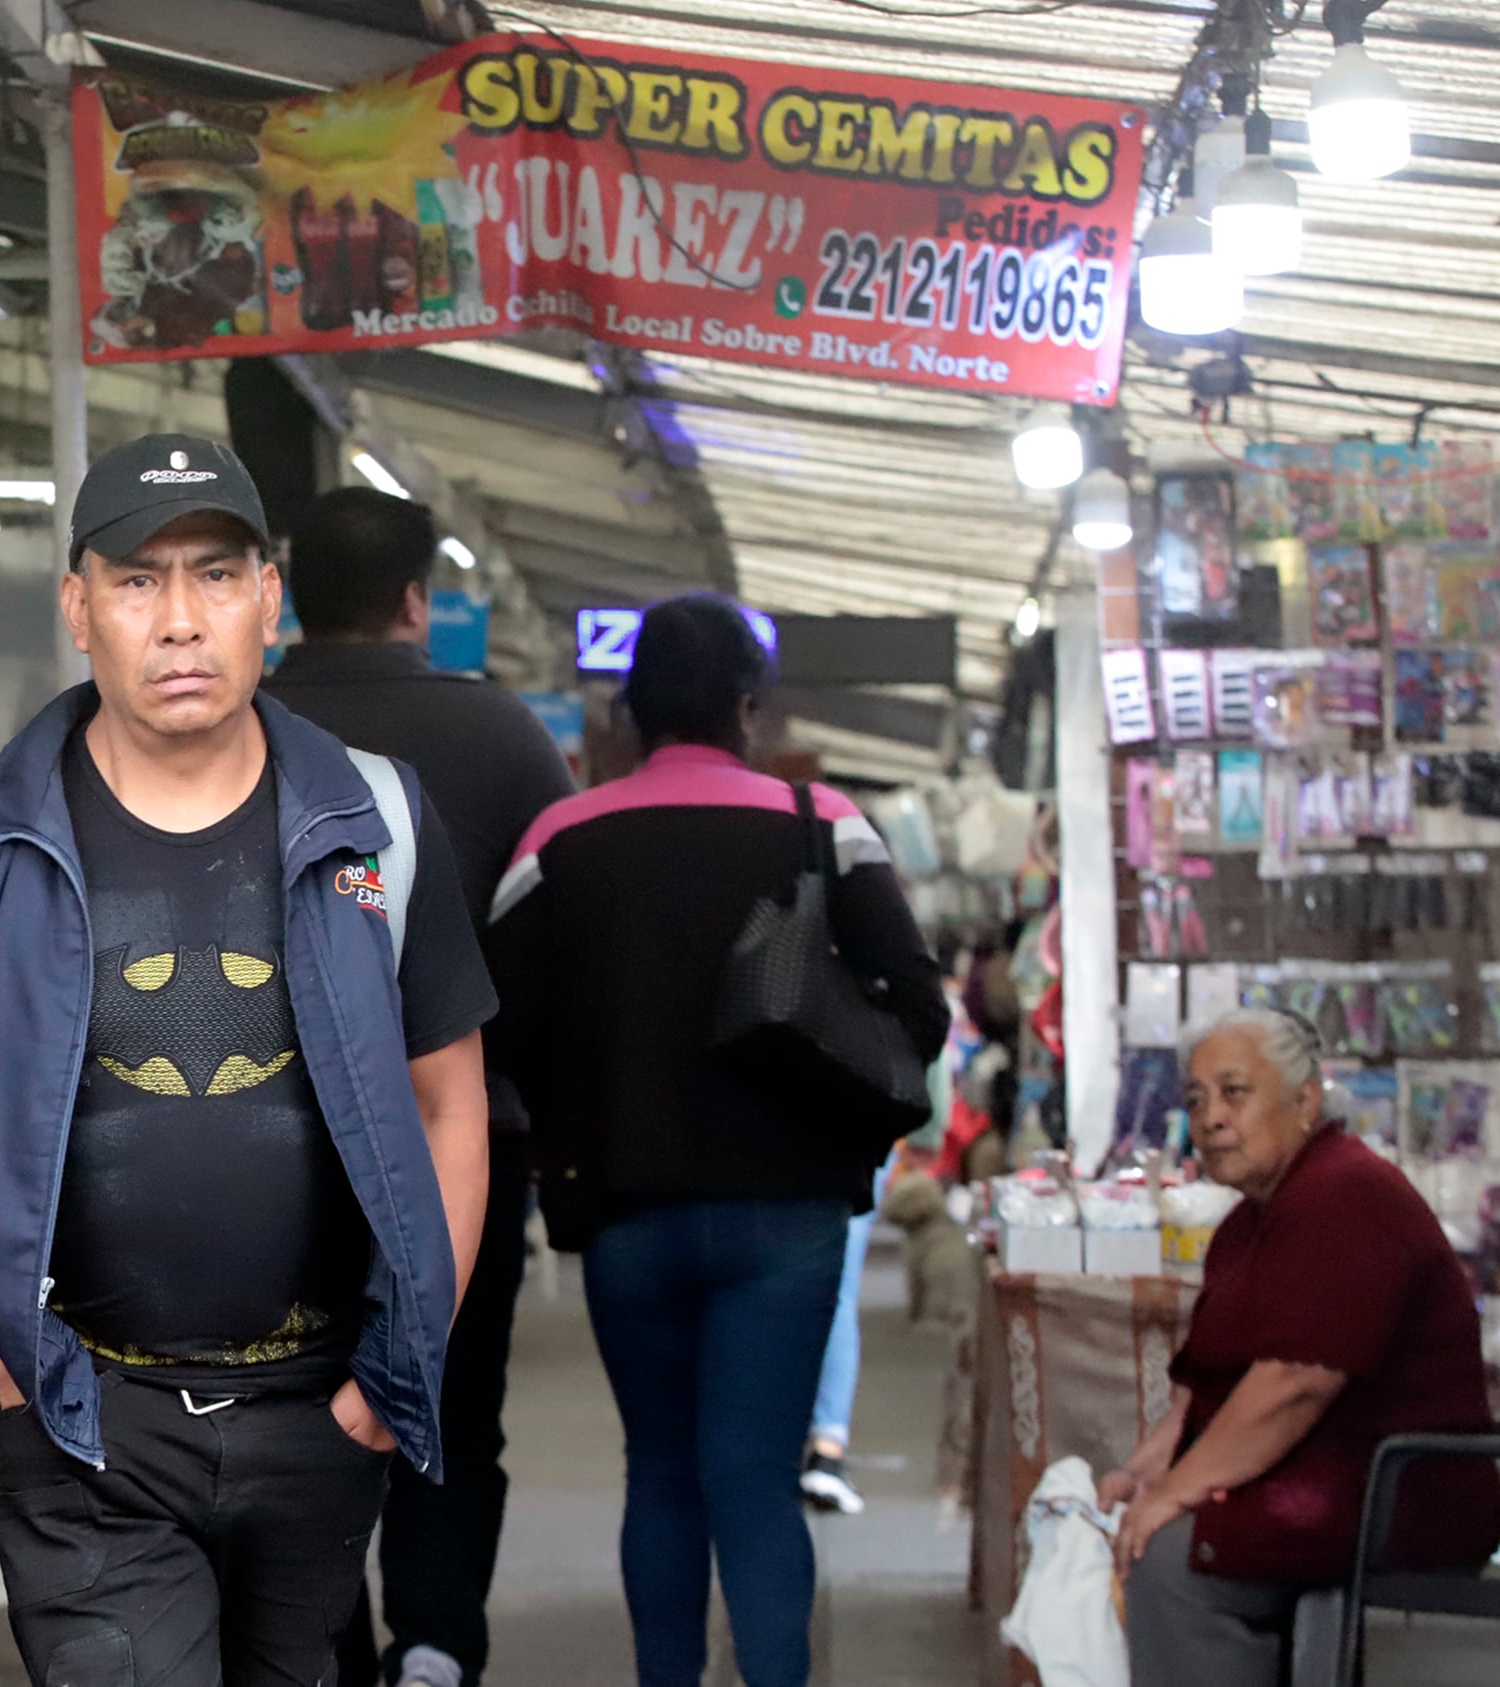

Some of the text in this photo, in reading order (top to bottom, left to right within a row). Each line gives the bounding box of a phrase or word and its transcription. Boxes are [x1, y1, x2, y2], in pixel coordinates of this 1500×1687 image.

[464, 54, 1113, 202] SUPER CEMITAS
[937, 198, 1116, 257] Pedidos:
[812, 230, 1112, 349] 2212119865
[351, 301, 498, 337] Mercado
[606, 304, 692, 346] Local
[700, 318, 801, 358] Sobre
[810, 332, 898, 369] Blvd.
[909, 348, 1009, 383] Norte
